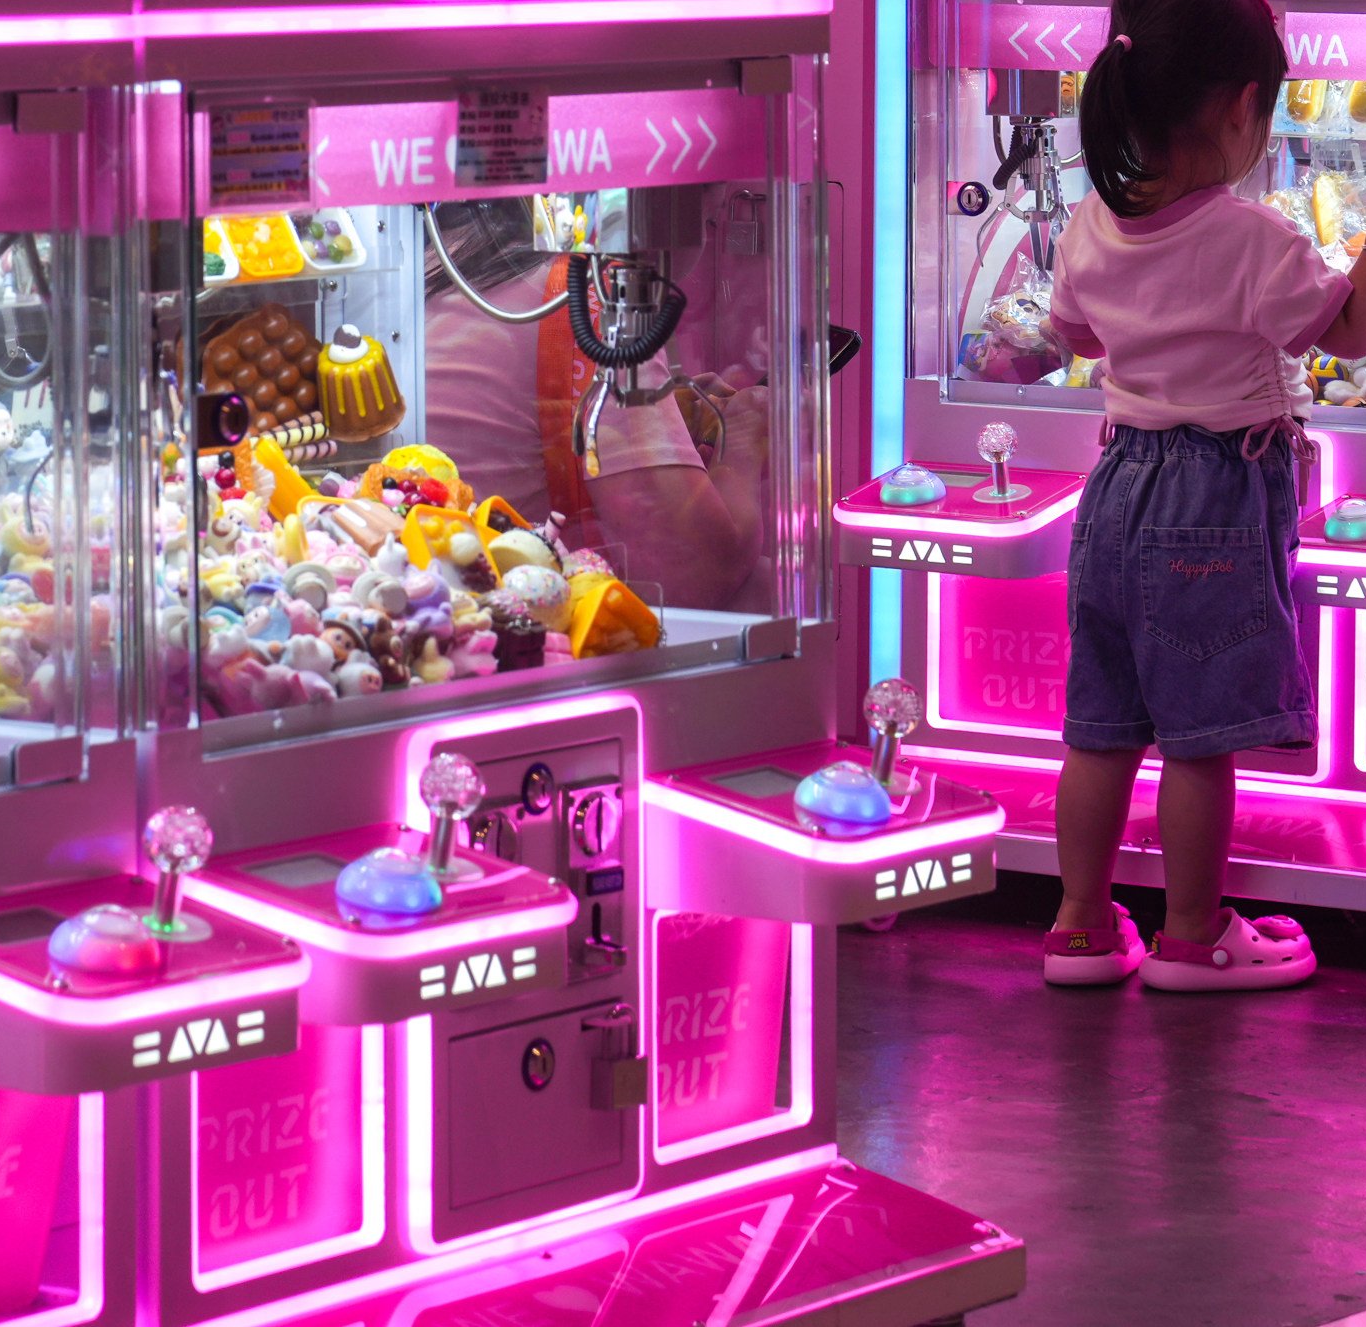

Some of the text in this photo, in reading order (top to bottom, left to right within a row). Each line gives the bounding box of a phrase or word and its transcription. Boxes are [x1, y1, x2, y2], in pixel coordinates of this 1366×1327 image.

[1287, 32, 1350, 68] WA
[371, 135, 434, 189] WE
[547, 126, 613, 175] WA
[1168, 559, 1234, 582] HappyBob
[963, 627, 1070, 667] PRIZ
[982, 673, 1067, 712] OUT
[209, 1162, 309, 1239] OUT
